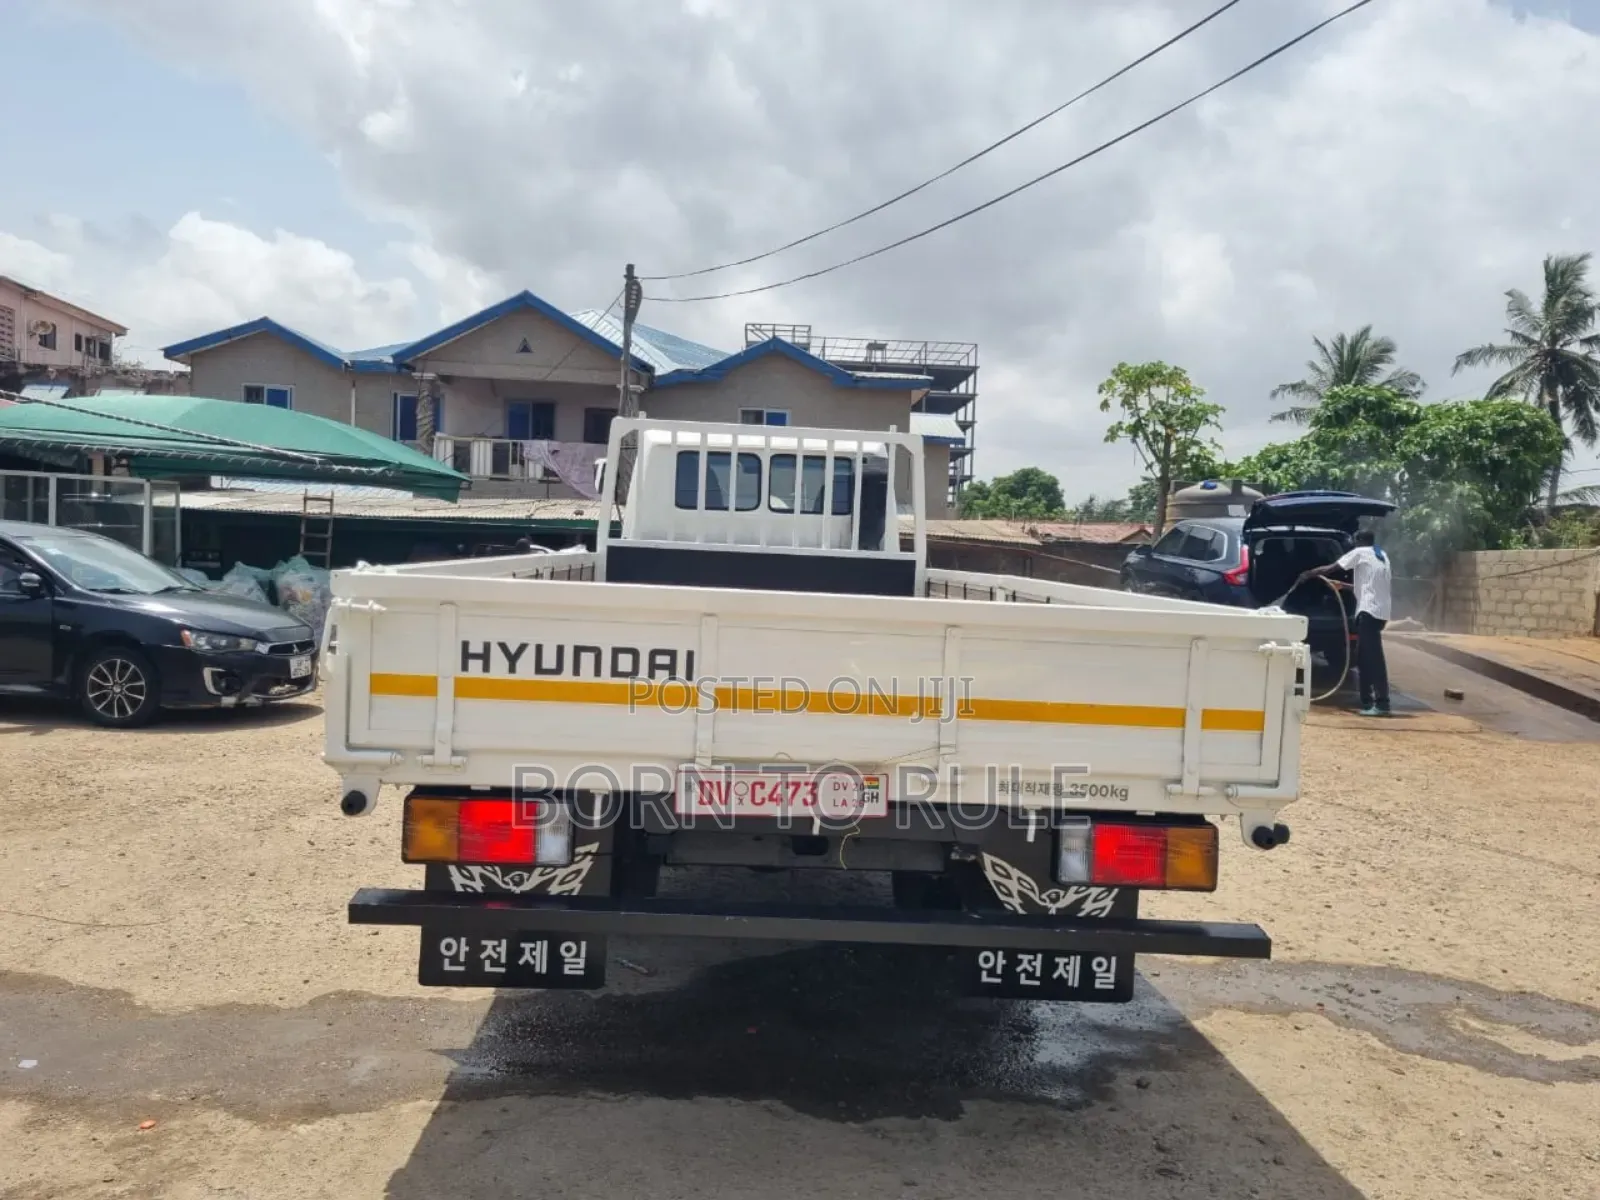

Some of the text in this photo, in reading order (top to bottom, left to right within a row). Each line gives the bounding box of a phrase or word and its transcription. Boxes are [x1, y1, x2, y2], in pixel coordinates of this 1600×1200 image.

[461, 640, 694, 681] HYUNDAI
[698, 780, 819, 807] DV C473
[833, 781, 849, 791] DV
[1069, 783, 1129, 801] 3500kg
[833, 798, 848, 807] LA
[862, 791, 880, 804] GH
